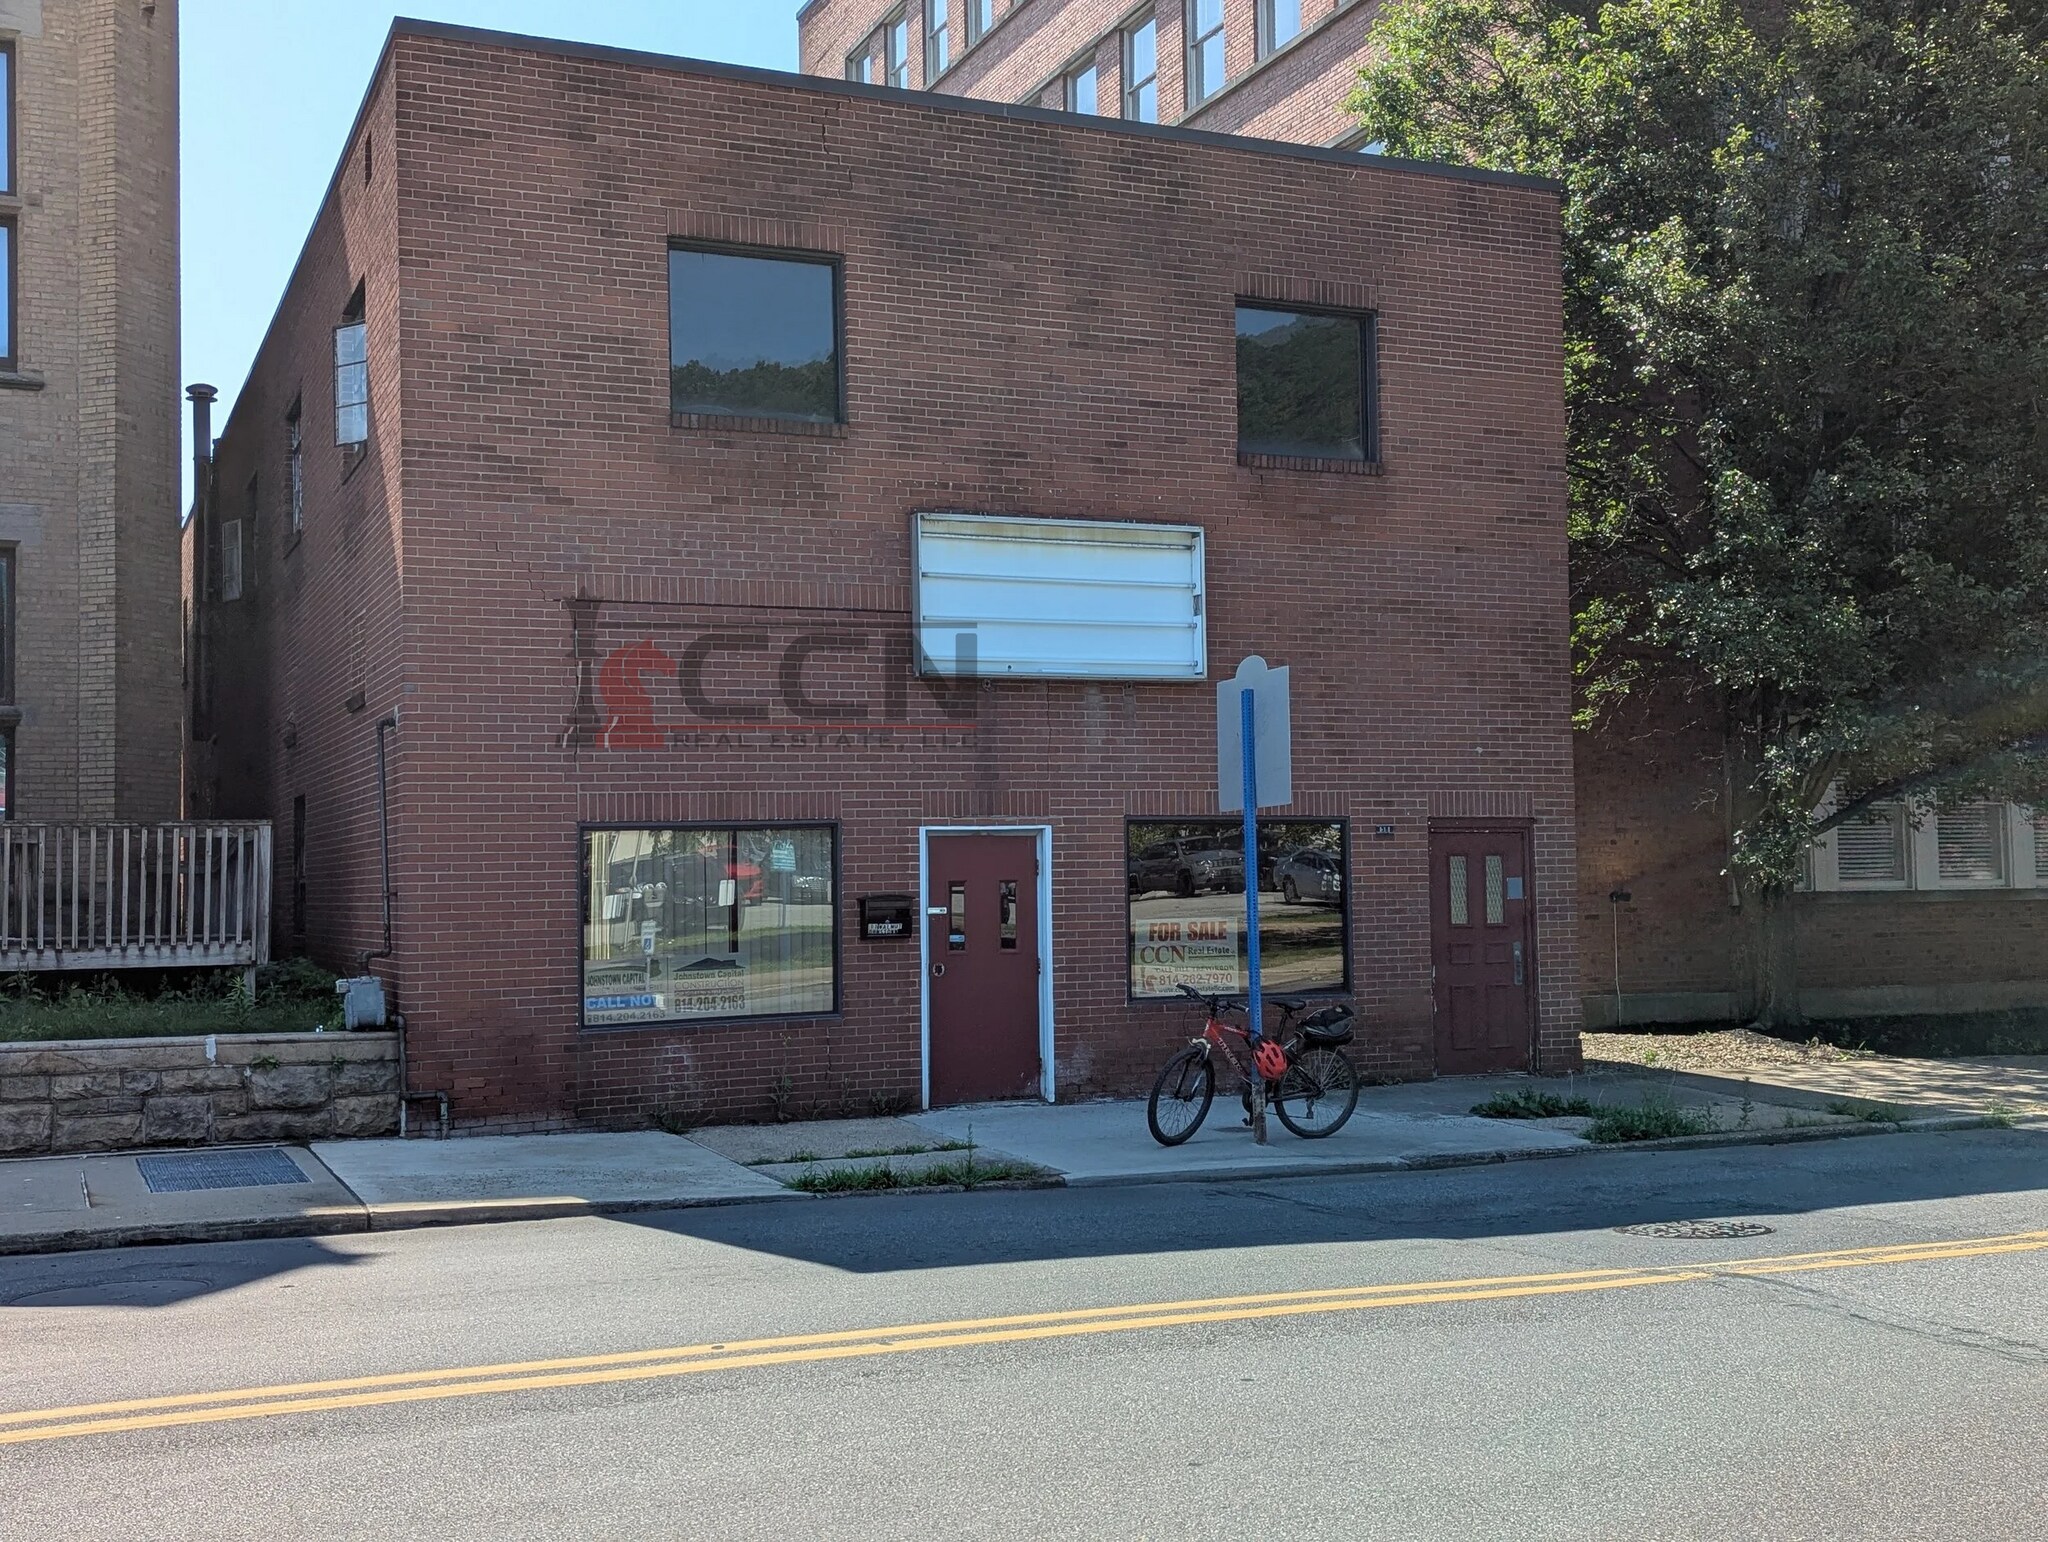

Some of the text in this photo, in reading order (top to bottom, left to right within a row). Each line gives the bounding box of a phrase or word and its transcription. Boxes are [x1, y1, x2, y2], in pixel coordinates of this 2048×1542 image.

[1148, 920, 1228, 942] FOR SALE
[1140, 944, 1188, 964] CCN
[1188, 946, 1205, 955] Real
[1207, 946, 1230, 955] Estate
[586, 973, 621, 986] JOHNSTOWN
[673, 969, 745, 981] Johnstown Capital
[674, 979, 745, 990] CONSTRUCTION
[586, 996, 626, 1009] CALL
